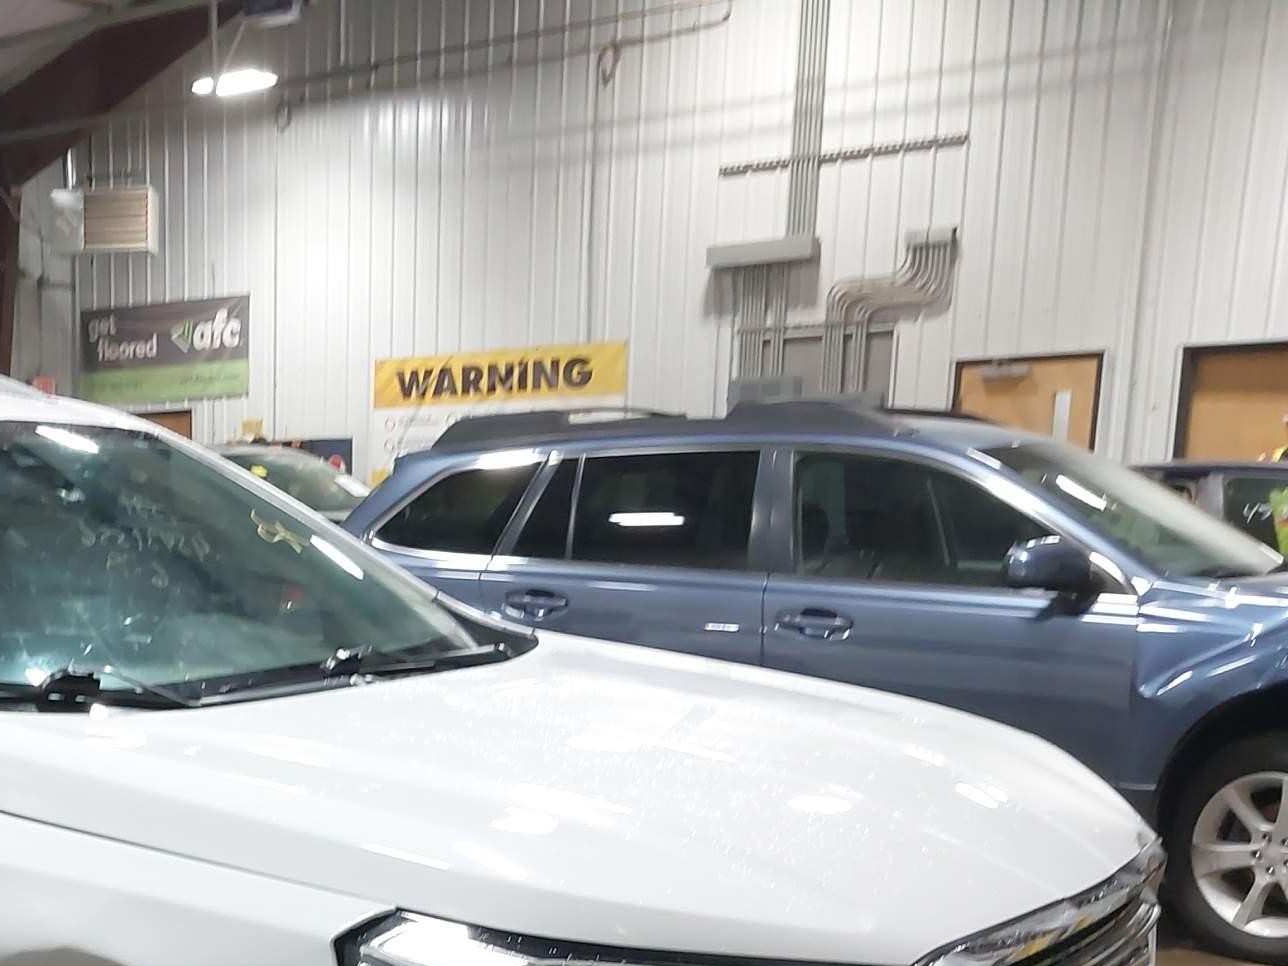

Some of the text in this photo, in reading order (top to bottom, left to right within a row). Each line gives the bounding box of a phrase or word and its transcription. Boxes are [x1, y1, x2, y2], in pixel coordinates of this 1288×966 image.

[88, 313, 117, 343] get
[192, 308, 242, 351] afc
[97, 332, 158, 361] floored
[396, 356, 594, 401] WARNING
